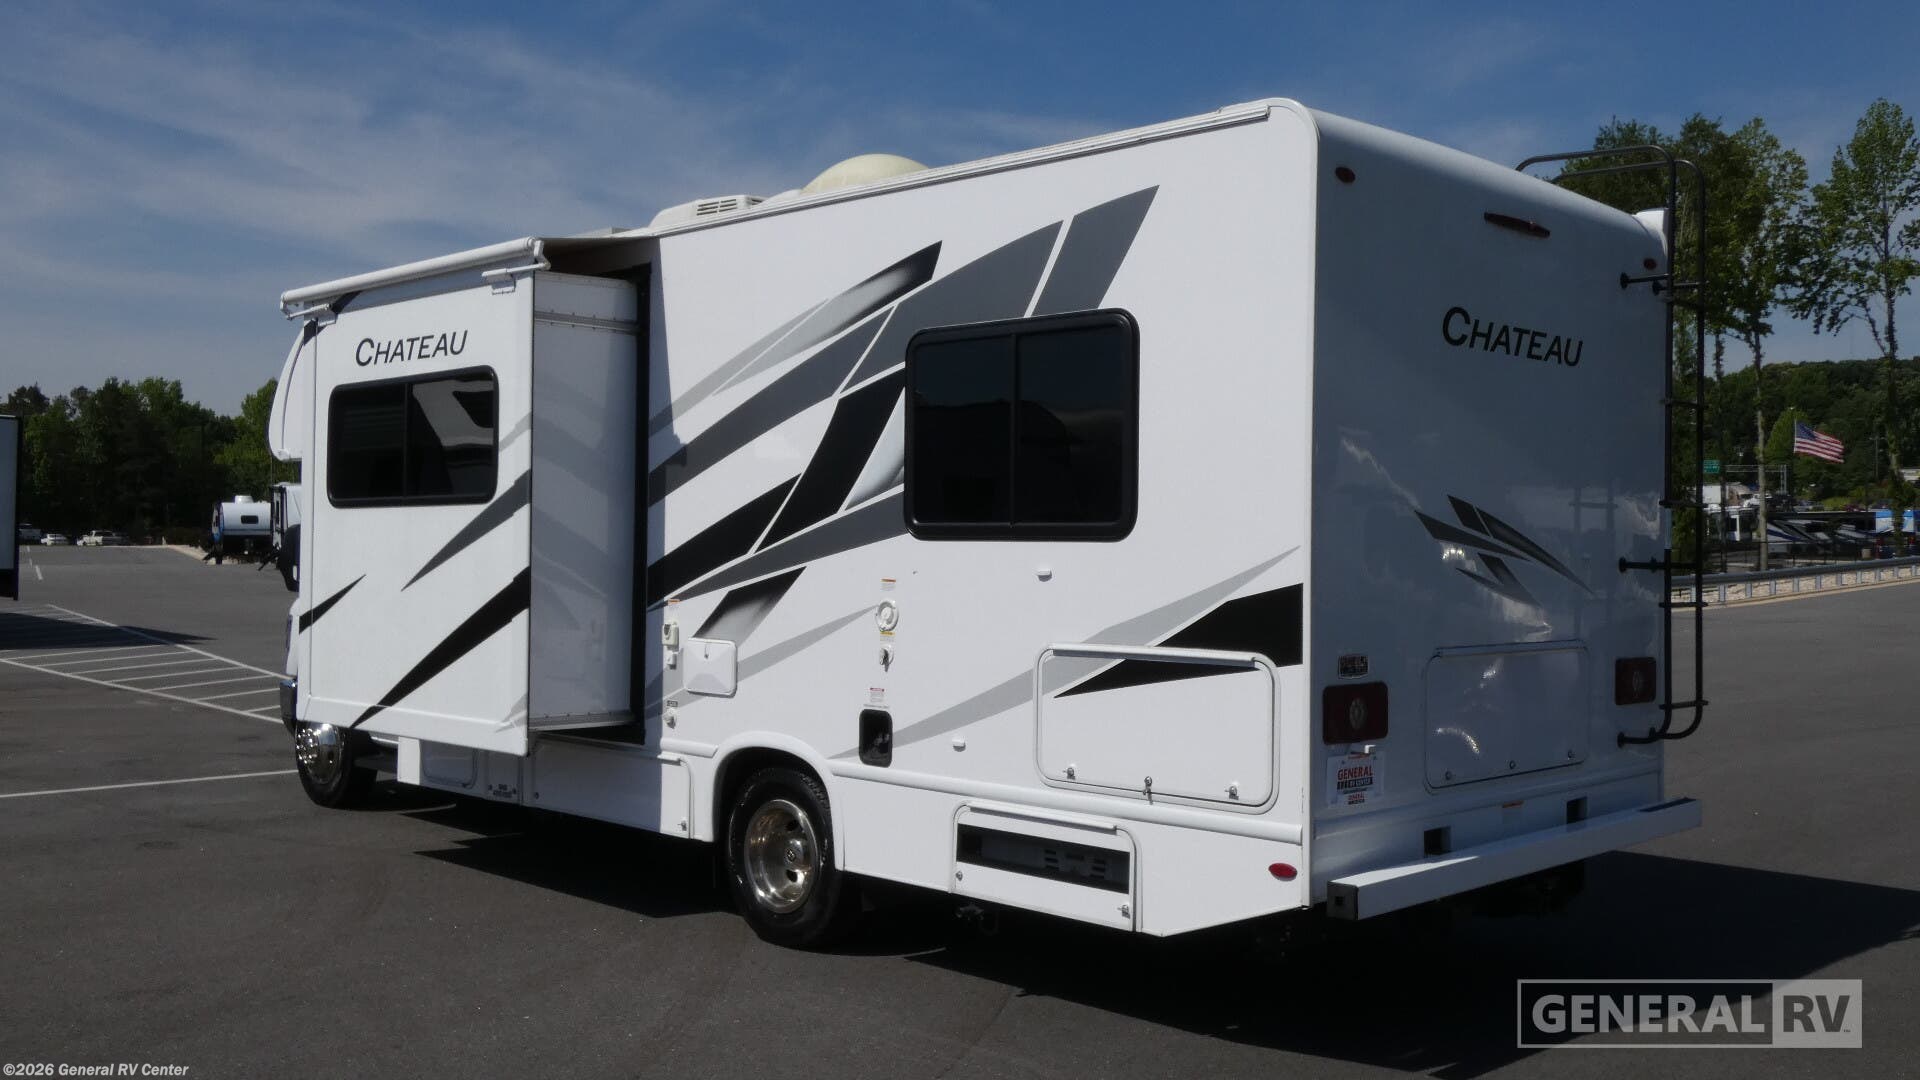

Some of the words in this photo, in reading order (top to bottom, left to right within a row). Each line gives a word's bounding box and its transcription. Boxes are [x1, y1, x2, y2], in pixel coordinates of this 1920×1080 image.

[355, 330, 468, 367] CHATEAU
[1442, 306, 1583, 367] CHATEAU
[1337, 765, 1373, 781] GENERAL
